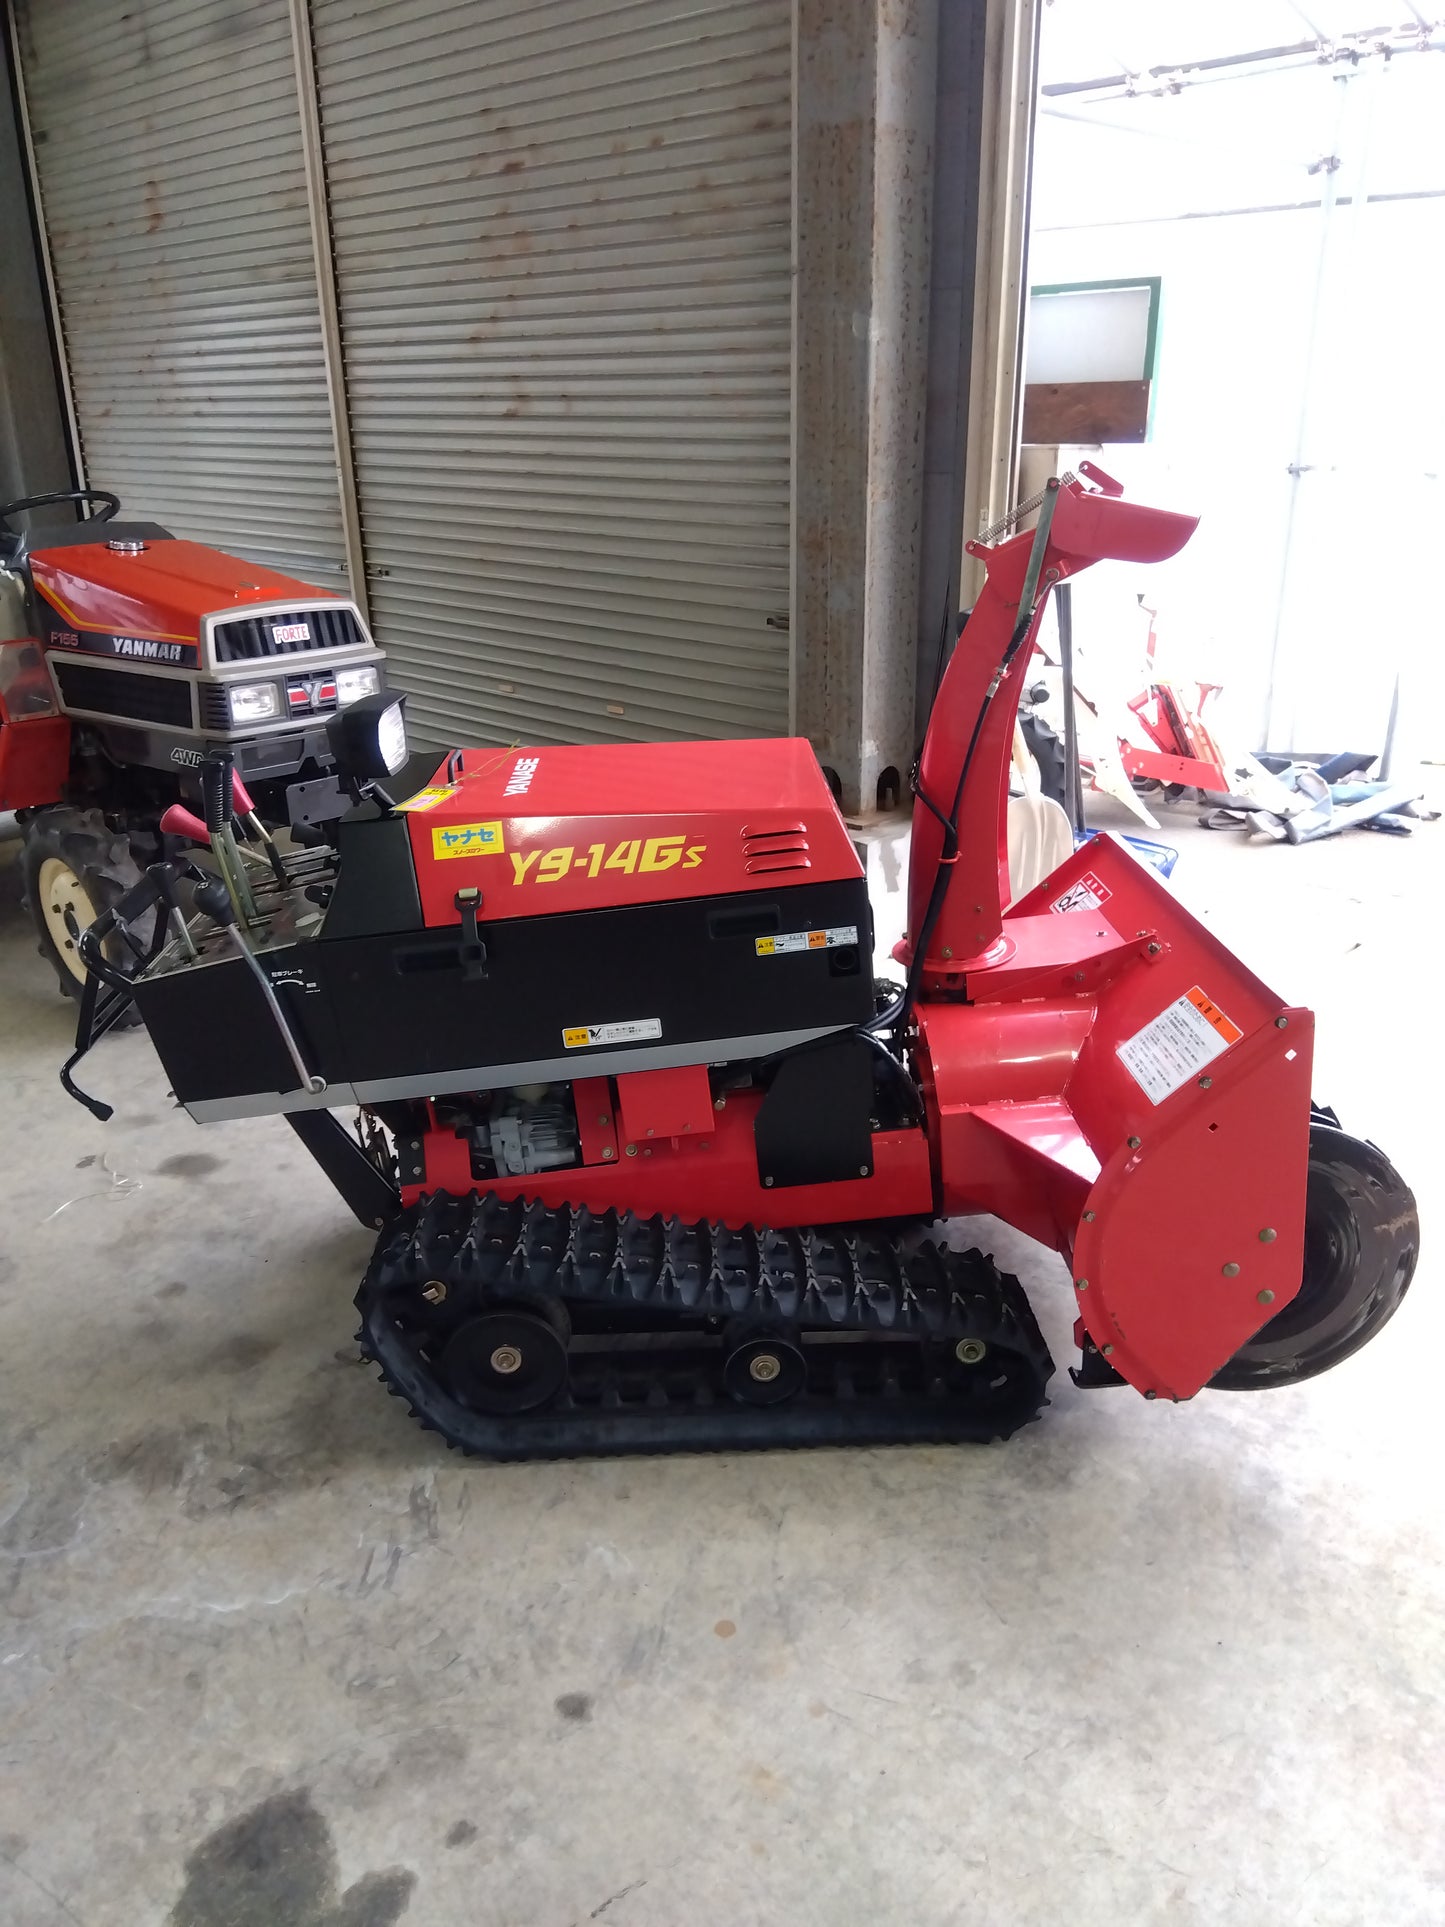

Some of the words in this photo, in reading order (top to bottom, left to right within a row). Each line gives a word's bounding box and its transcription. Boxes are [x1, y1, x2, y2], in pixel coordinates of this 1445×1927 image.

[275, 626, 308, 641] FORTE
[112, 637, 182, 661] YANMAR
[503, 757, 541, 797] YANASE
[441, 828, 494, 847] ヤナセ
